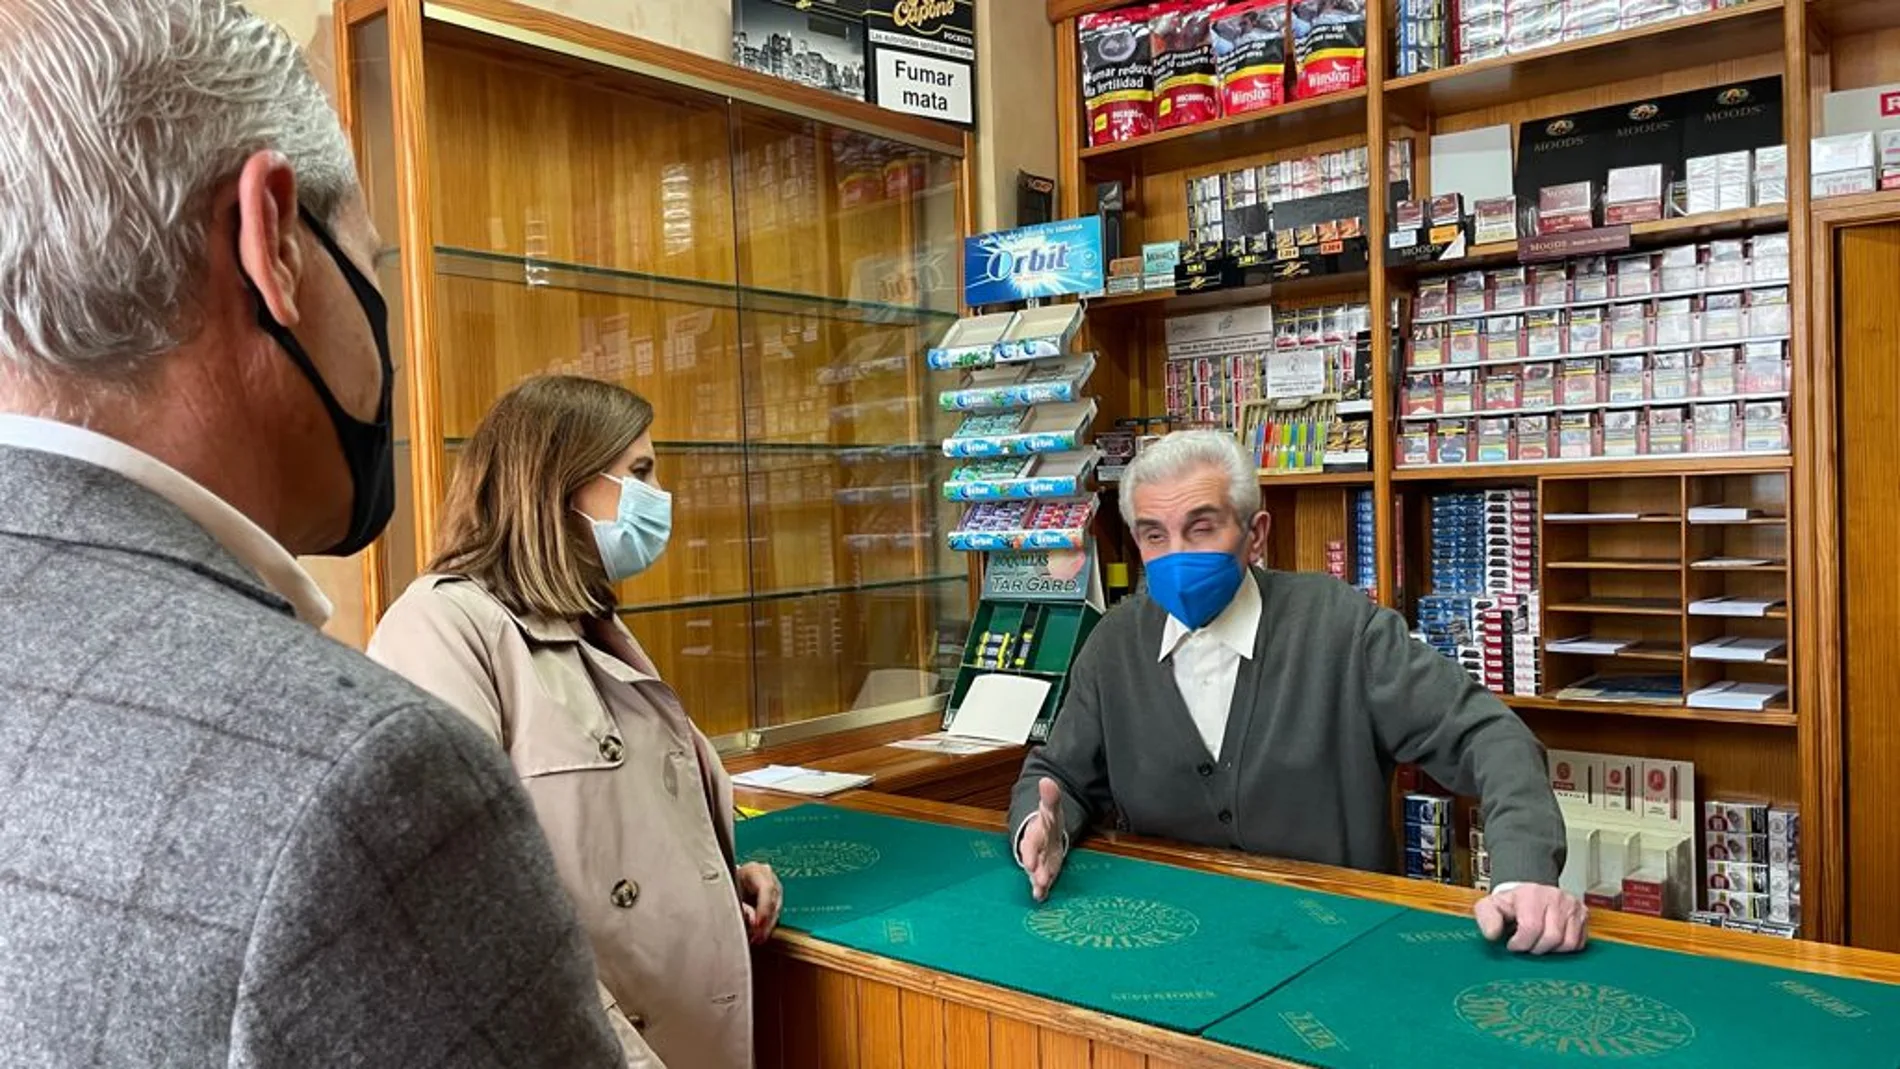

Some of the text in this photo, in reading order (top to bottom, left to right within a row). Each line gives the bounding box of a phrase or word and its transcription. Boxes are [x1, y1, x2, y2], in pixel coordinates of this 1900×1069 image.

[893, 0, 955, 27] Capone
[943, 31, 973, 45] POCKETS
[894, 60, 955, 87] Fumar
[1118, 62, 1154, 77] reduce
[1096, 75, 1145, 94] fertilidad
[1308, 70, 1350, 88] Winston
[902, 88, 948, 111] mata
[1232, 87, 1272, 105] Winston
[1704, 106, 1762, 123] MOODS
[1616, 122, 1671, 138] MOODS
[1533, 136, 1585, 152] MOODS
[1401, 244, 1442, 256] MOODS
[1530, 239, 1568, 252] MOODS
[986, 240, 1070, 281] Orbit
[960, 440, 989, 456] Orbit
[1024, 437, 1055, 452] Orbit
[960, 483, 990, 499] Orbit
[1024, 481, 1055, 497] Orbit
[965, 534, 994, 549] Orbit
[1029, 532, 1061, 547] Orbit
[992, 577, 1023, 592] TAR
